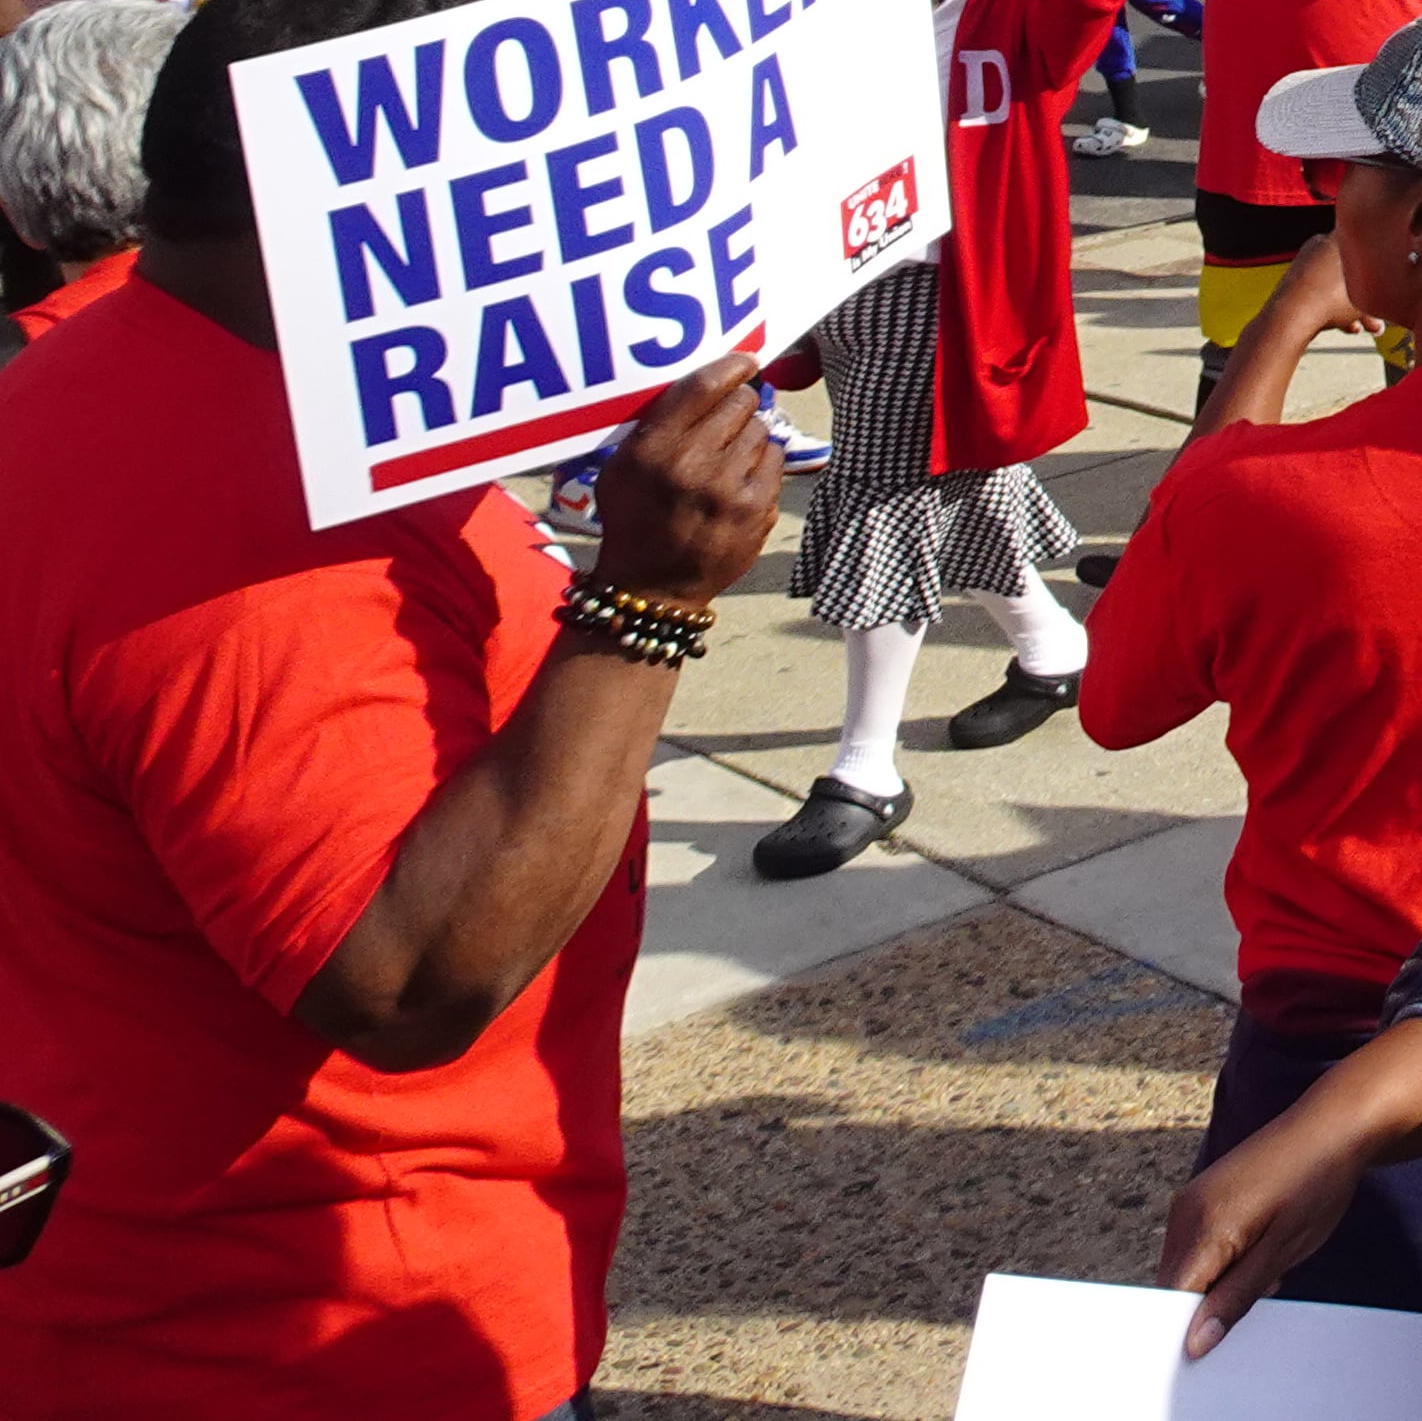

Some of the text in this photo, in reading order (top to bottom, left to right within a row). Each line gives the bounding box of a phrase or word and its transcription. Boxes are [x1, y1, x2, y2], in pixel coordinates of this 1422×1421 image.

[958, 49, 1013, 128] D
[328, 51, 799, 323] NEED A
[848, 179, 880, 210] UNITE
[848, 179, 909, 248] 634
[350, 202, 763, 447] RAISE
